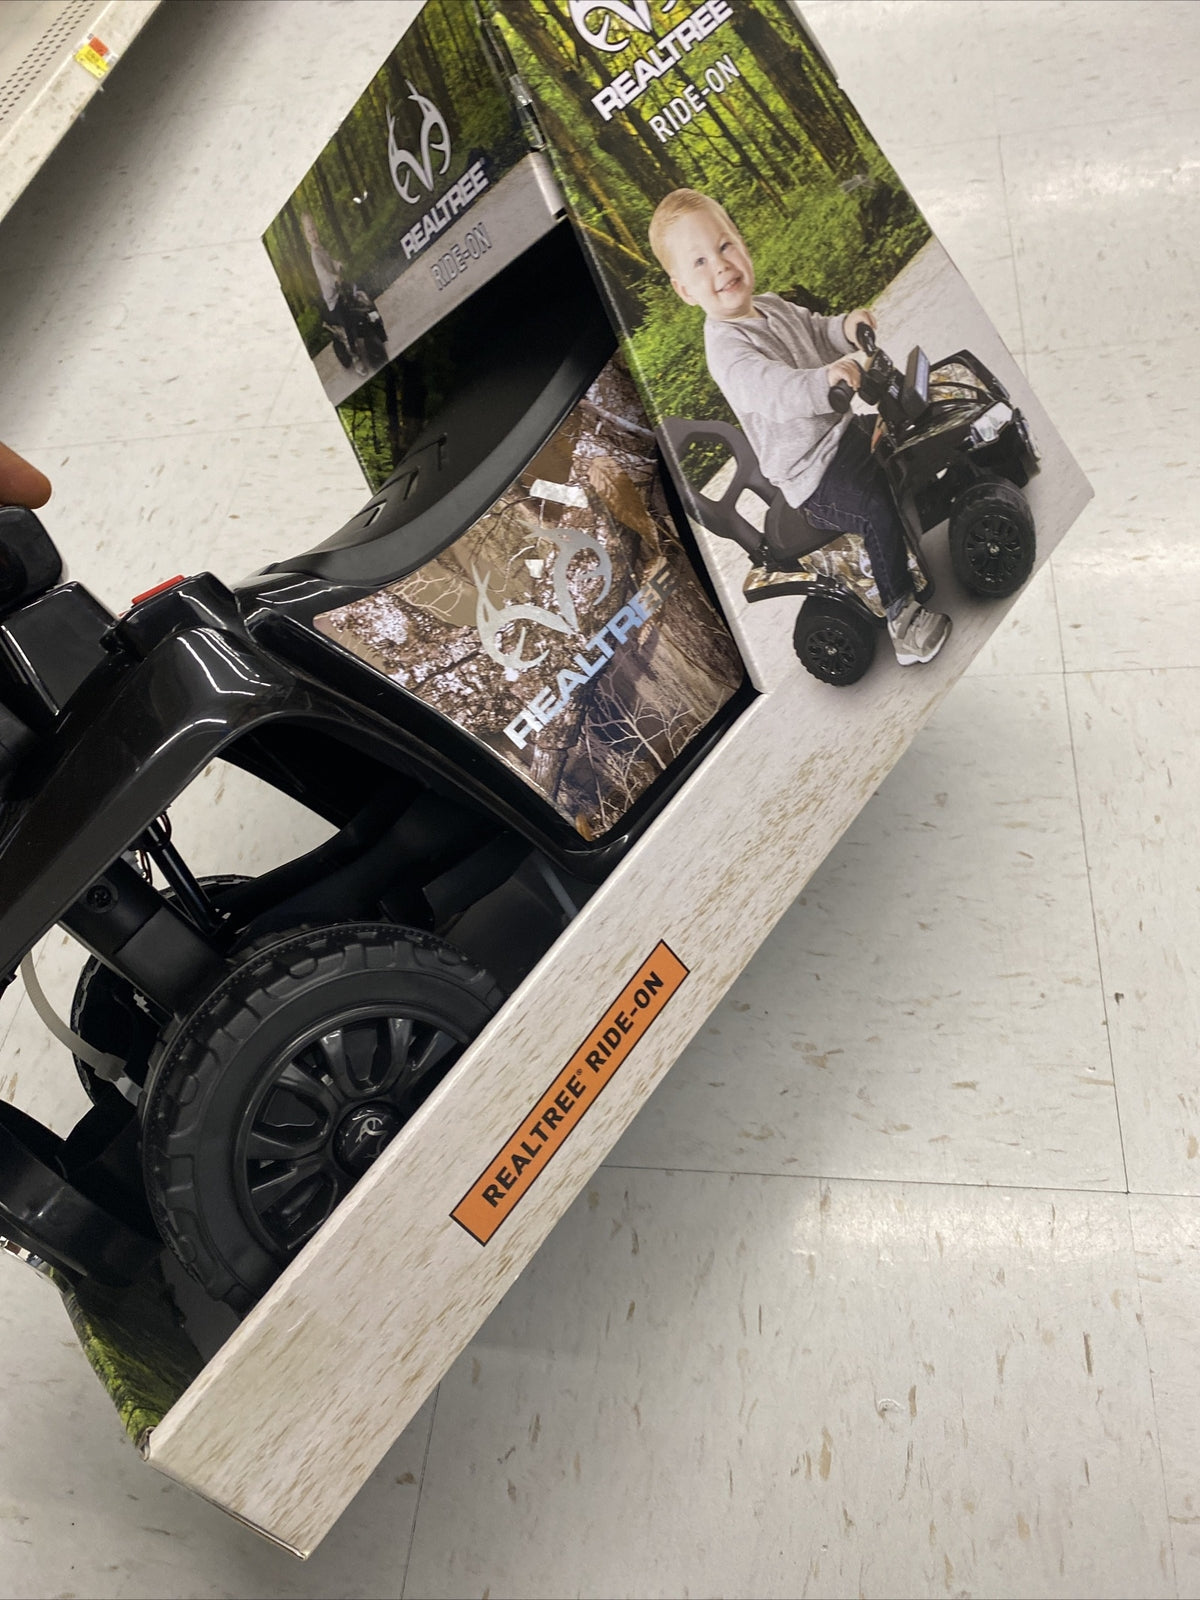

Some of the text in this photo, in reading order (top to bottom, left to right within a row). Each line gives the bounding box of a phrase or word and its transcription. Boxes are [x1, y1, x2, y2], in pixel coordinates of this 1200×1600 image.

[590, 0, 734, 121] REALTREE
[648, 54, 741, 144] RIDE-ON
[400, 159, 489, 260] REALTREE
[430, 221, 492, 291] RIDE-ON
[502, 563, 680, 750] REALTREE
[584, 970, 665, 1074] RIDE-ON
